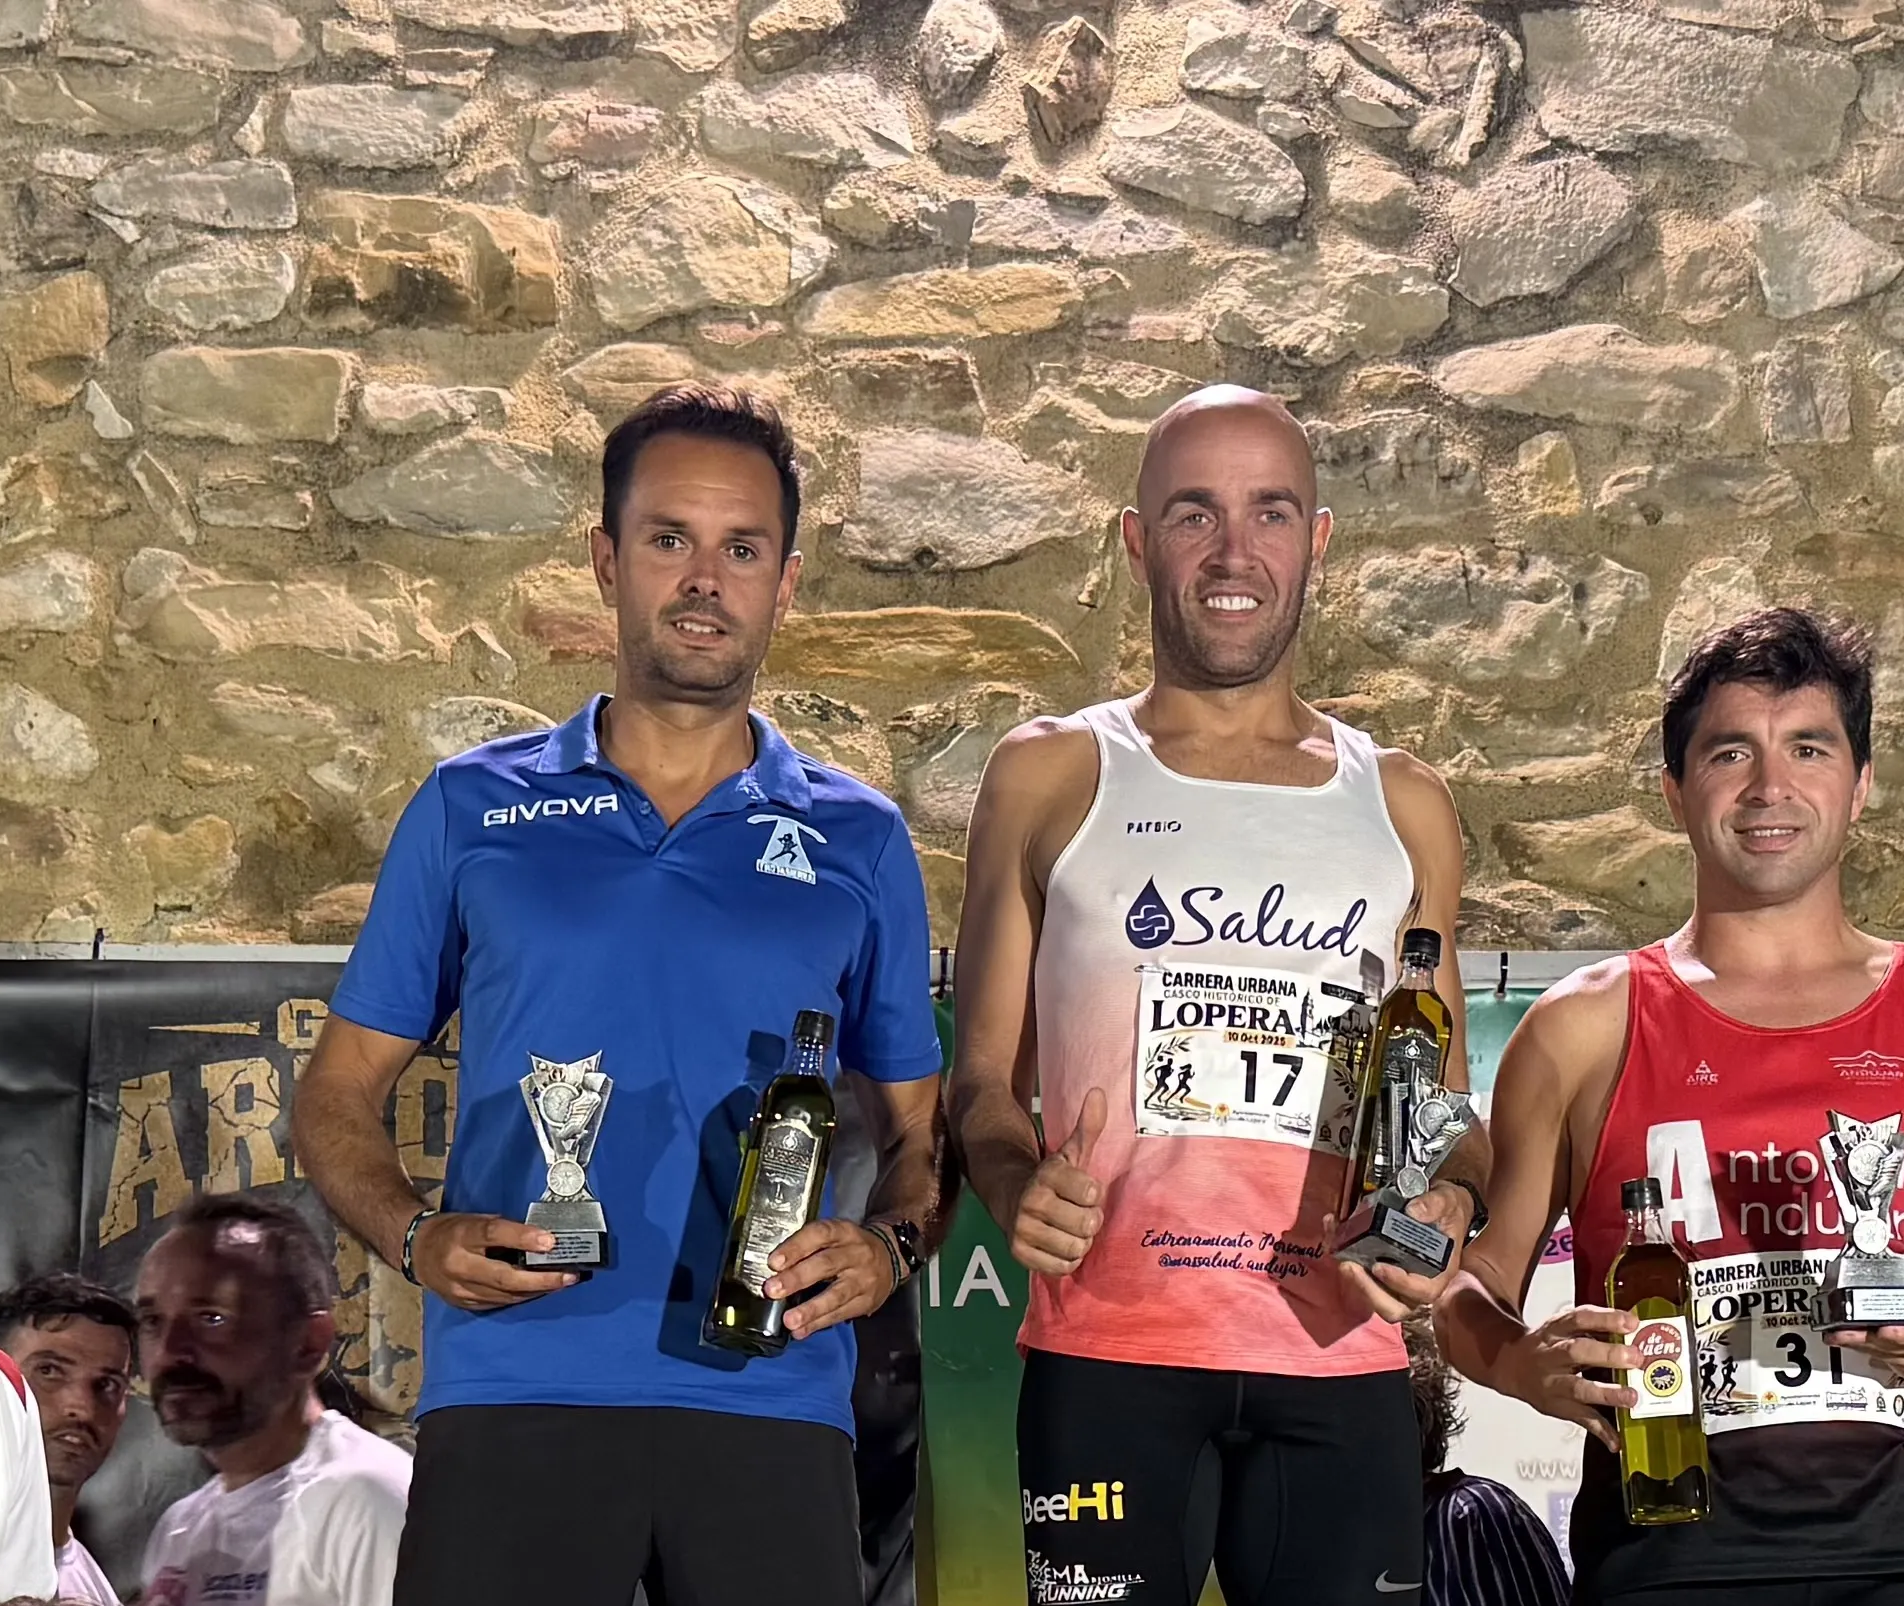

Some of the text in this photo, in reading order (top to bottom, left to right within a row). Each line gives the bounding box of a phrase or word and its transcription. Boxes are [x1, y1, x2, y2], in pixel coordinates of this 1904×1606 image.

[483, 793, 619, 827] GIVOVA
[1172, 883, 1367, 957] Salud
[1162, 971, 1234, 991] CARRERA
[1238, 977, 1297, 998] URBANA
[1164, 988, 1201, 1000] CASCO
[1150, 1000, 1297, 1036] LOPERA
[1240, 1050, 1304, 1107] 17
[1694, 1262, 1767, 1287] CARRERA
[1697, 1284, 1734, 1298] CASCO
[1694, 1287, 1818, 1329] LOPER
[1774, 1332, 1843, 1388] 31
[1022, 1481, 1124, 1525] BeeHi
[1037, 1583, 1127, 1604] RUNNING
